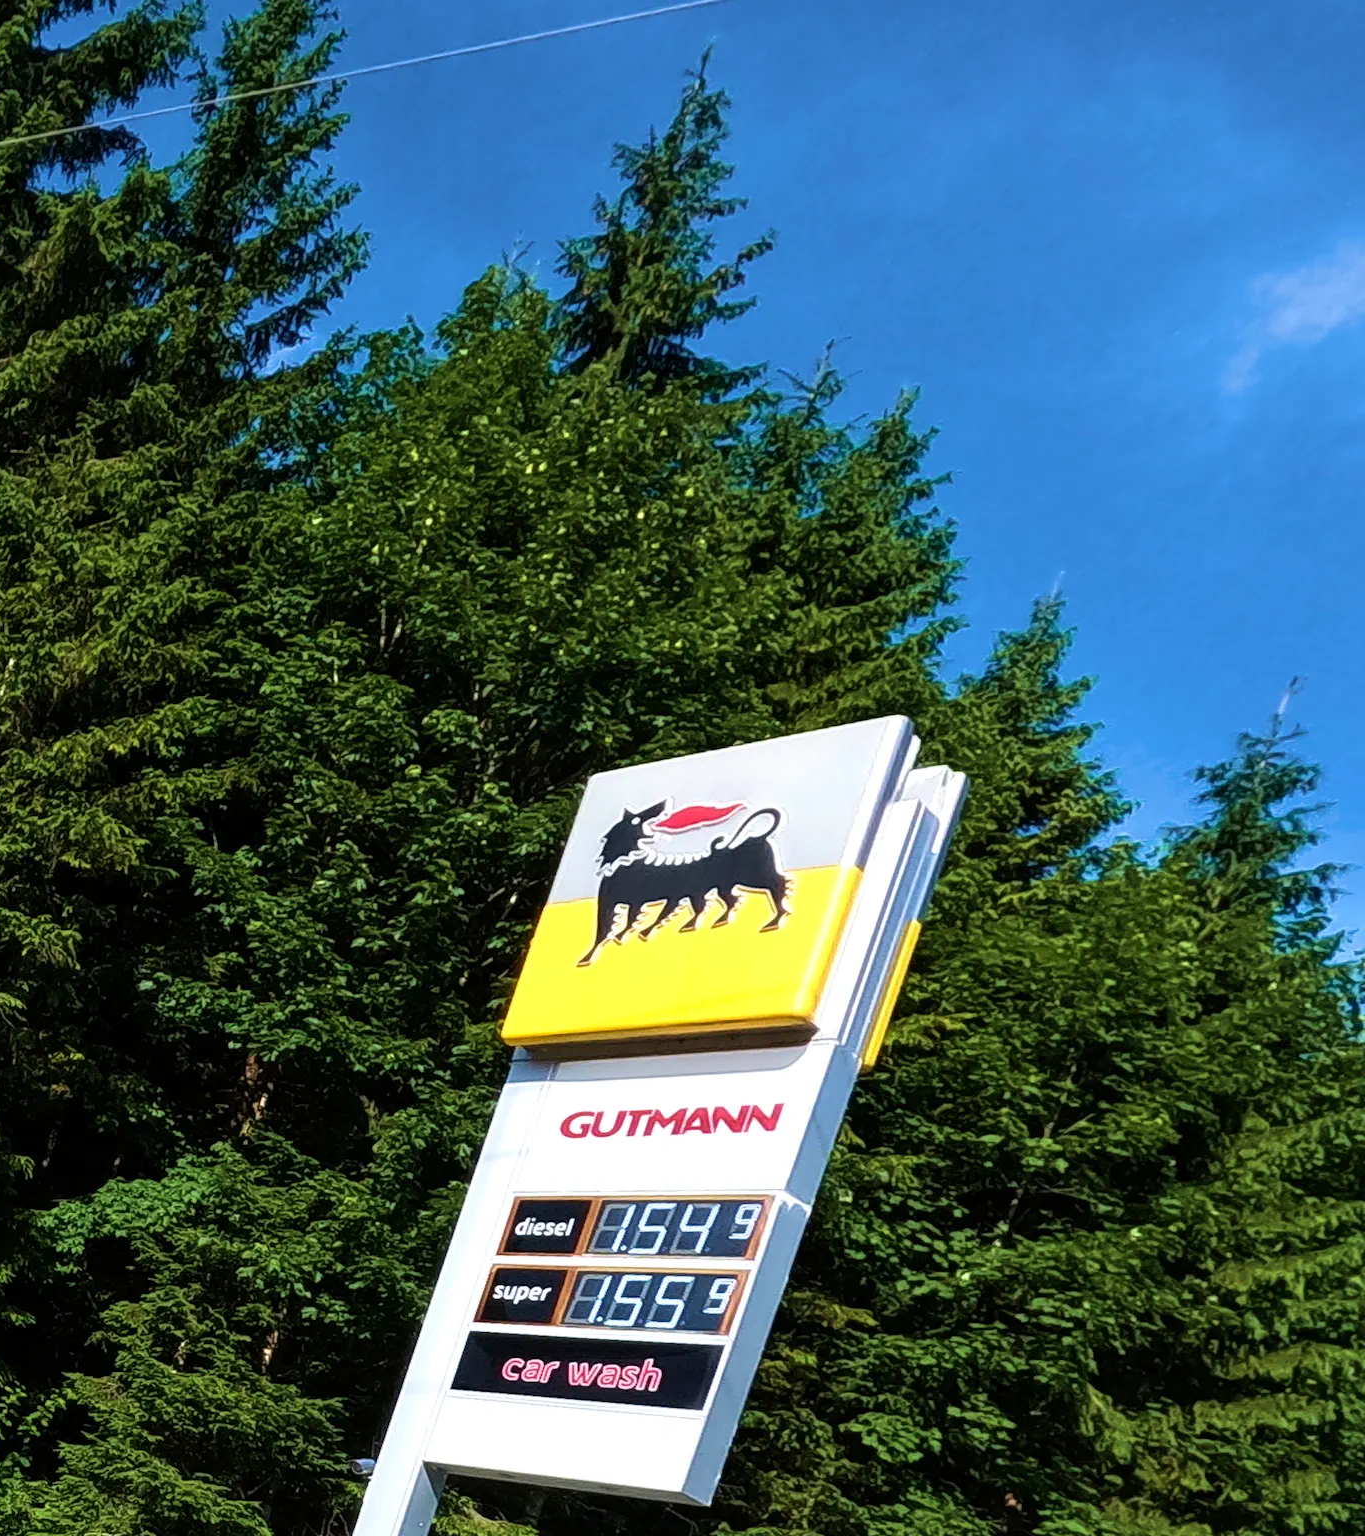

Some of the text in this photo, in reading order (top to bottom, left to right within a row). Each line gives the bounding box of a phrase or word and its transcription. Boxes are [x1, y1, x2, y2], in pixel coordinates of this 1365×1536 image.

[559, 1103, 785, 1139] GUTMANN
[514, 1216, 575, 1237] diesel
[492, 1283, 552, 1305] super
[501, 1356, 663, 1391] car wash
